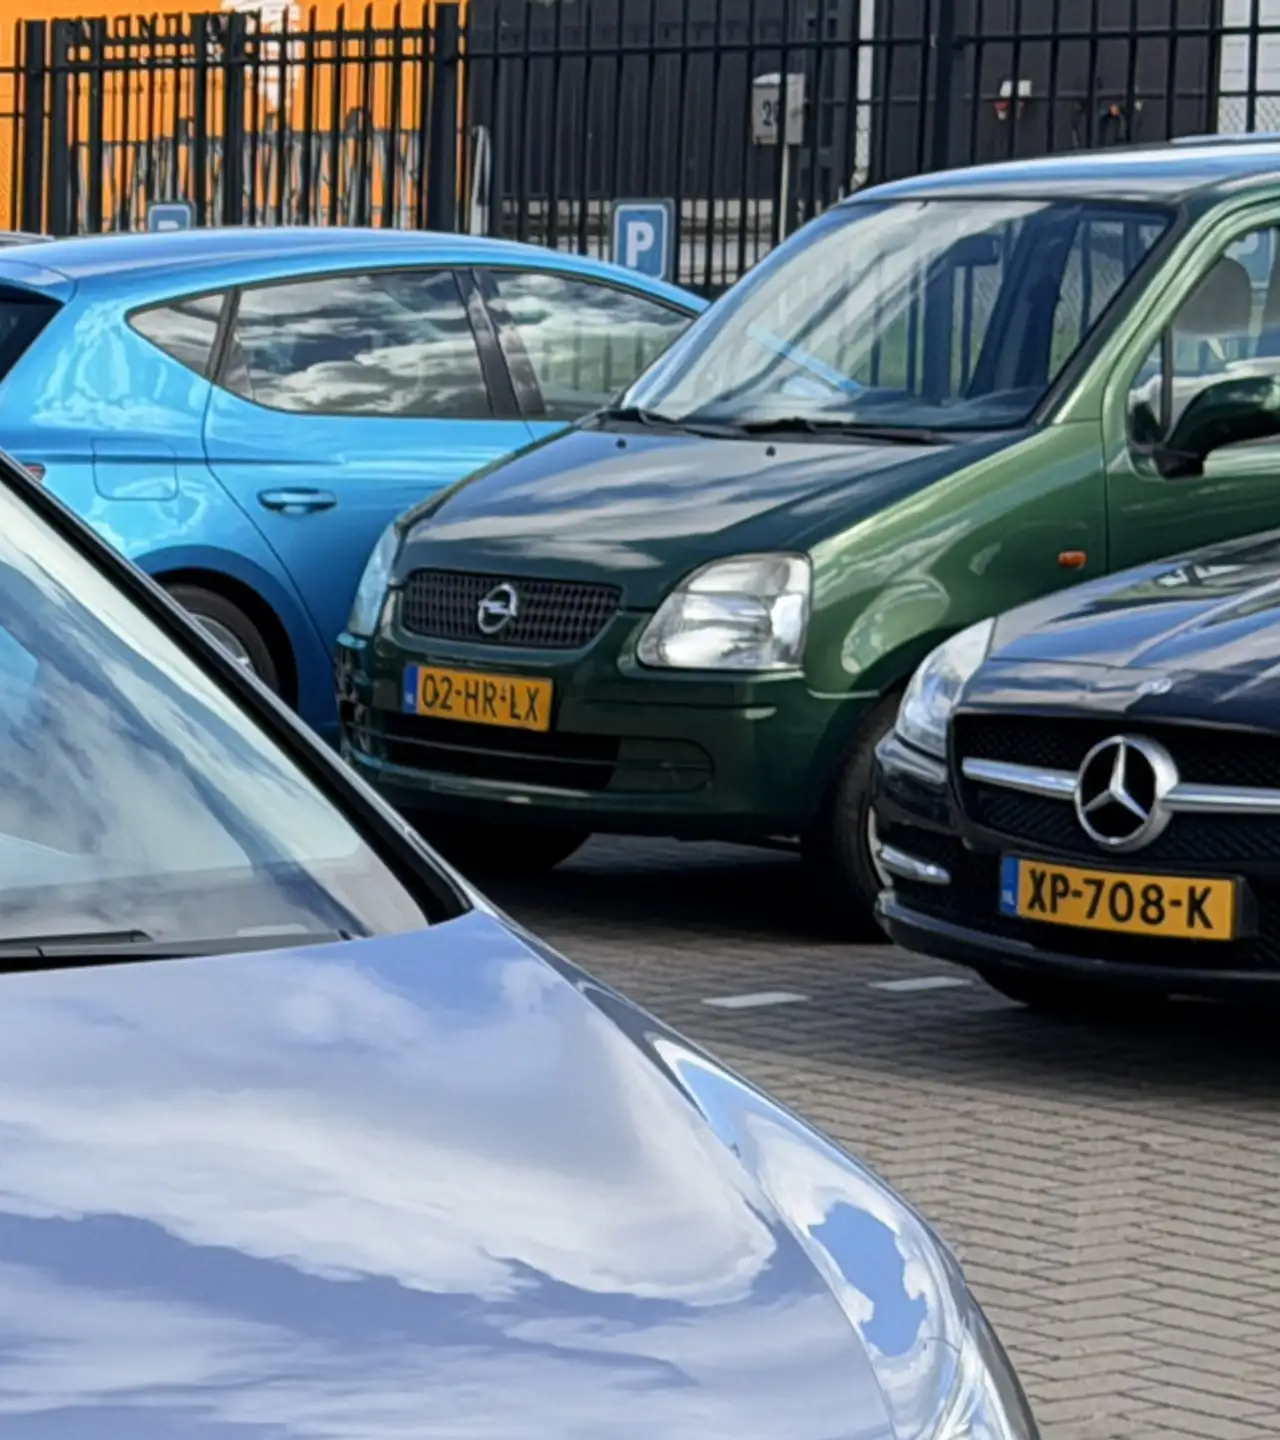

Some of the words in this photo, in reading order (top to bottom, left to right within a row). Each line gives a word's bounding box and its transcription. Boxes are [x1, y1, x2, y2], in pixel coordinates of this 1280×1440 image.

[626, 221, 655, 268] P
[421, 673, 541, 723] 02-HR-LX
[1027, 867, 1215, 931] XP-708-K
